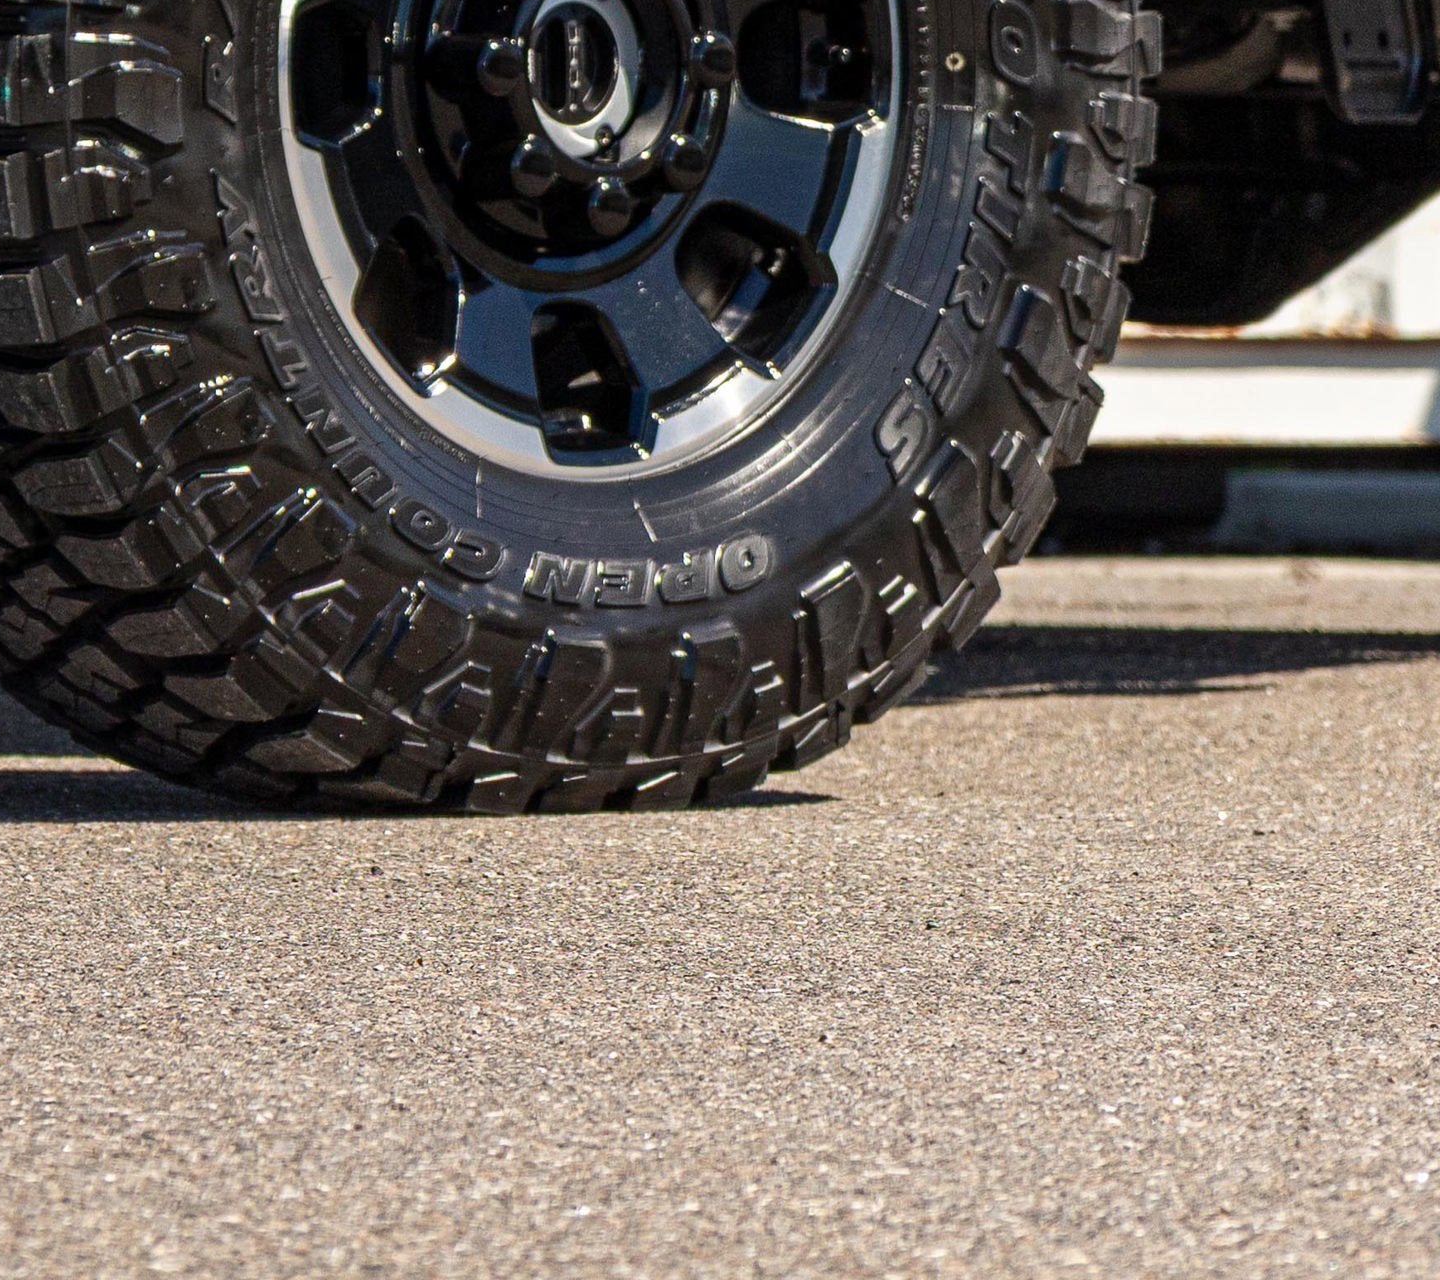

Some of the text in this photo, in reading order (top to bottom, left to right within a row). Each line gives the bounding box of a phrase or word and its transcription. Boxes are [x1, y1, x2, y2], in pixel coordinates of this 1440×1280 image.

[210, 168, 508, 581] COUNTRY
[872, 109, 1038, 487] TIRES
[523, 530, 778, 607] OPEN
